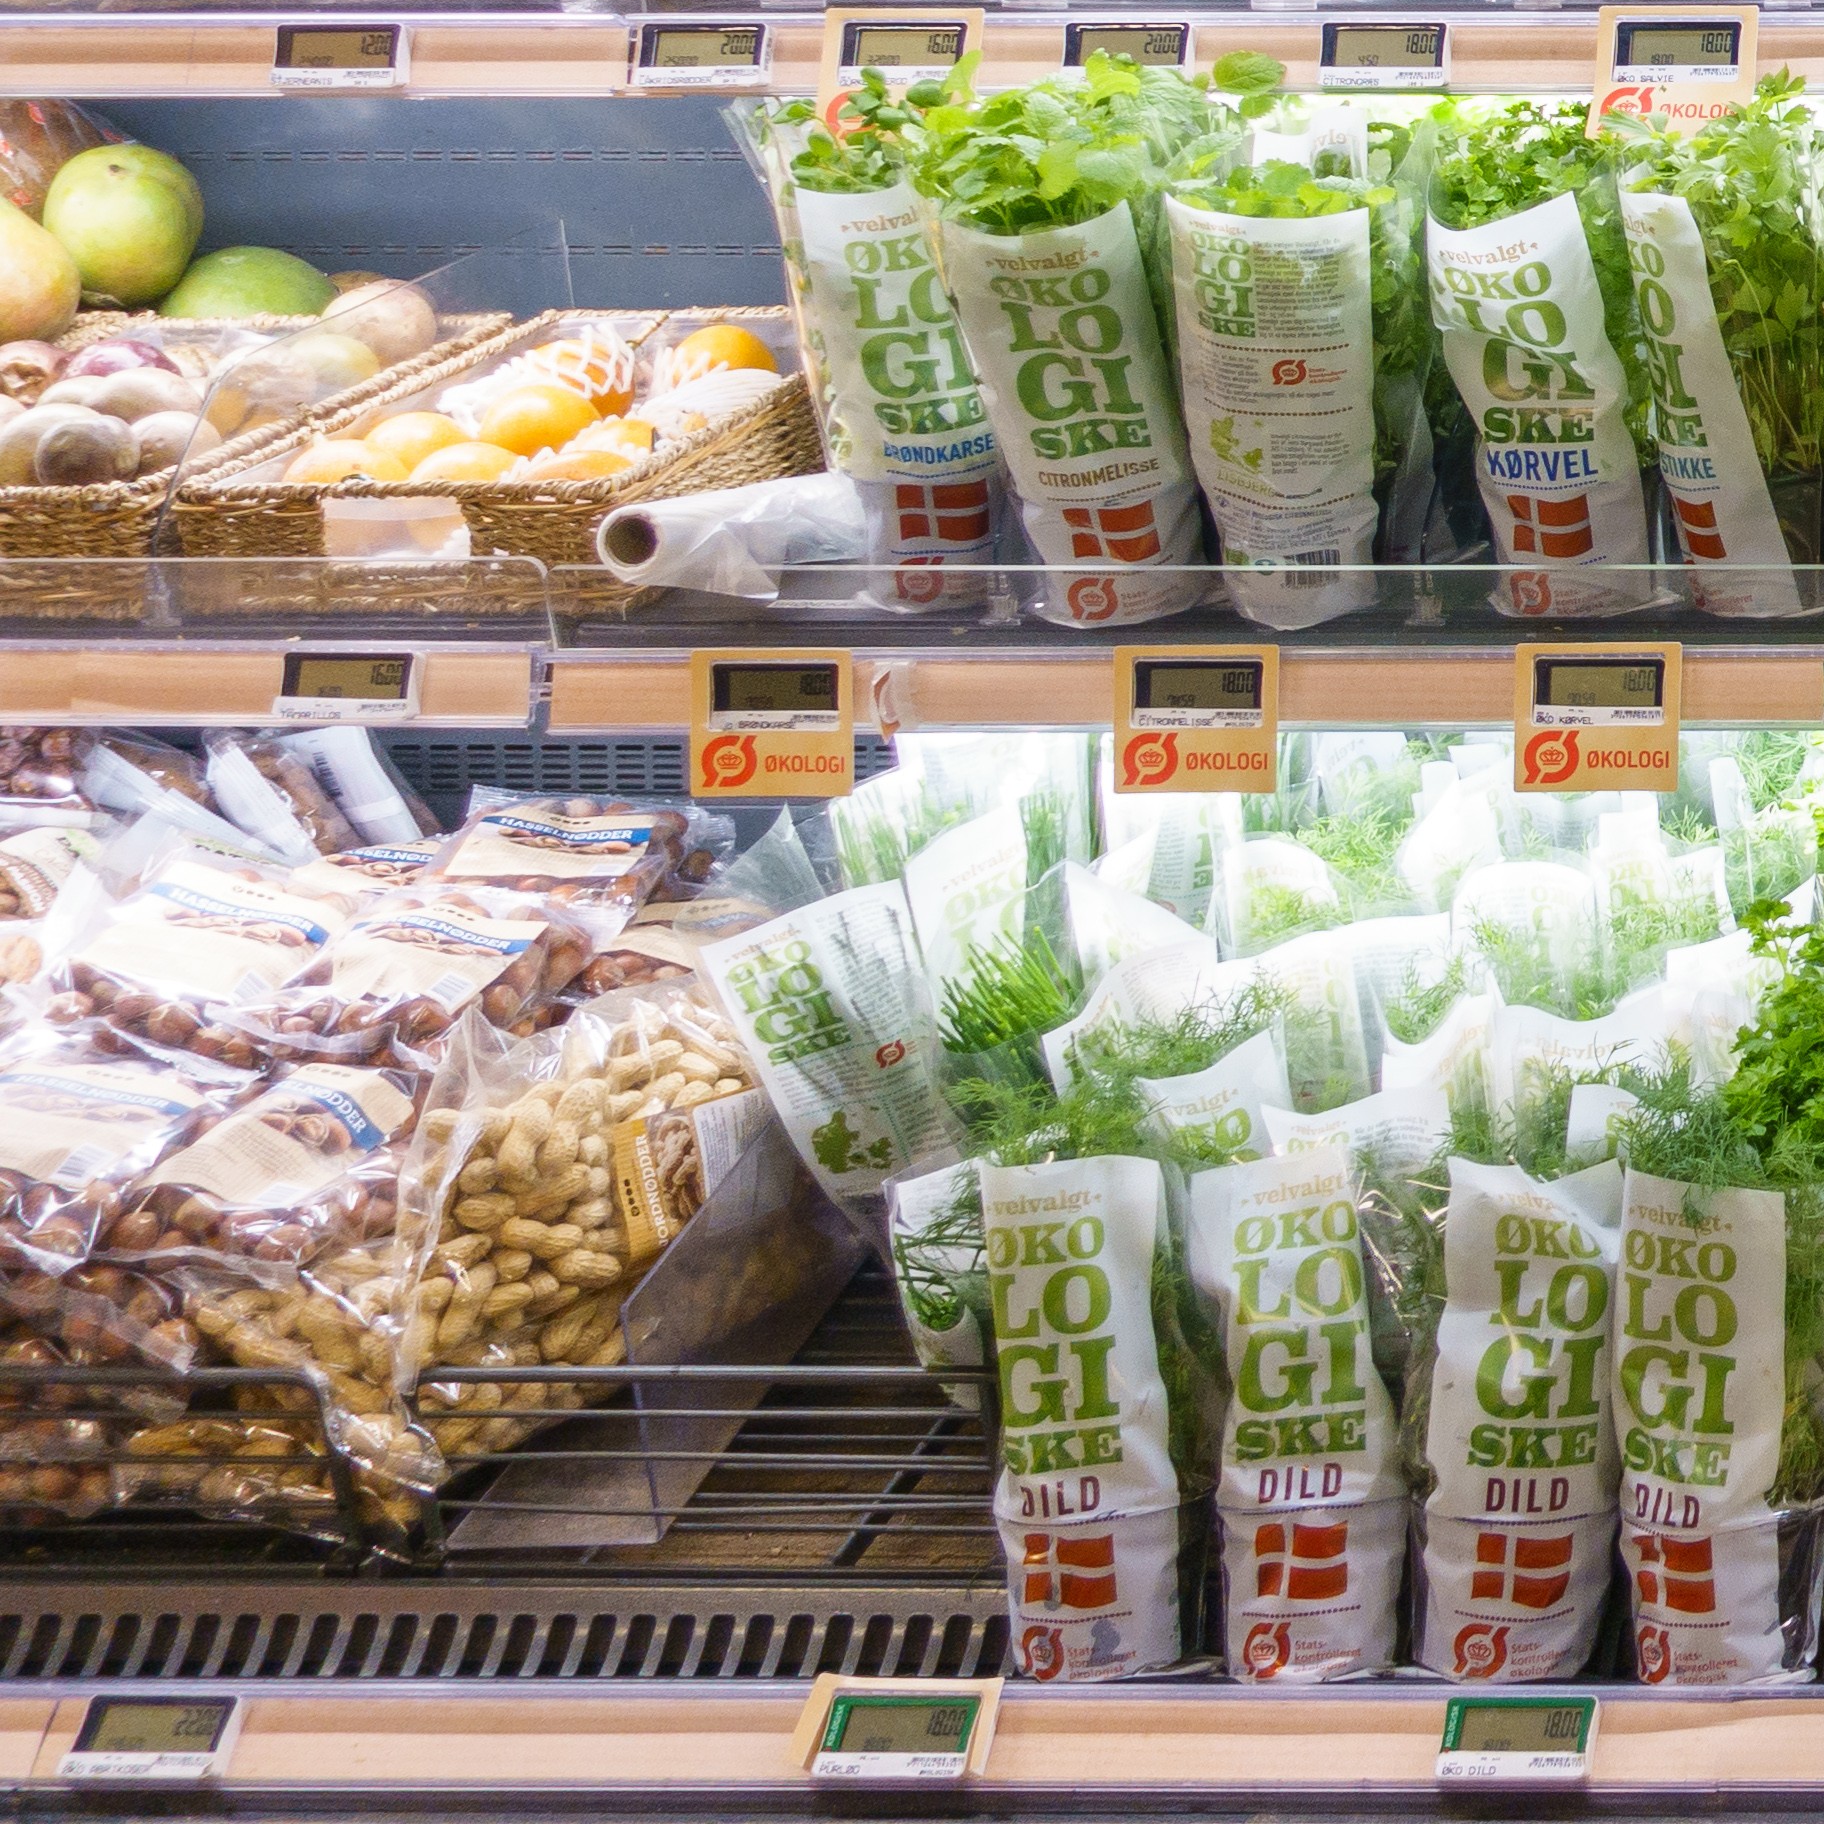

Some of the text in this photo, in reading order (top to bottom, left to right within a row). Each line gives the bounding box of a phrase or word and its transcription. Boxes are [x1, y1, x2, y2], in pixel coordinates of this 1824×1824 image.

[1640, 74, 1675, 83] SALVIE
[994, 248, 1091, 275] velvalgt
[1441, 260, 1552, 299] ØKO
[990, 268, 1113, 306] ØKO
[1007, 302, 1123, 353] LO
[1462, 303, 1569, 350] LO
[1017, 351, 1145, 421] GI
[1481, 336, 1595, 402] GI
[1032, 417, 1151, 460] SKE
[1483, 407, 1594, 445] SKE
[883, 431, 995, 464] BRØNDKARSE
[1486, 445, 1599, 484] KØRVEL
[1038, 457, 1160, 488] CITRONMELISSE
[1137, 717, 1214, 727] CITRONMELISSE
[1535, 715, 1594, 726] ØKO KØRVEL
[764, 753, 846, 774] ØKOLOGI
[1185, 750, 1269, 773] ØKOLOGI
[1586, 748, 1670, 770] ØKOLOGI
[499, 815, 634, 841] HASSELNØDDER
[1623, 1228, 1738, 1285] ØKO
[1622, 1281, 1739, 1349] LO
[1621, 1343, 1738, 1435] GI
[1622, 1424, 1731, 1487] SKE
[1020, 1474, 1102, 1518] DILD
[1257, 1461, 1345, 1503] DILD
[1485, 1477, 1571, 1515] DILD
[1635, 1481, 1702, 1530] DILD
[1542, 1710, 1582, 1737] 18.00
[1441, 1765, 1497, 1776] ØKO DILD
